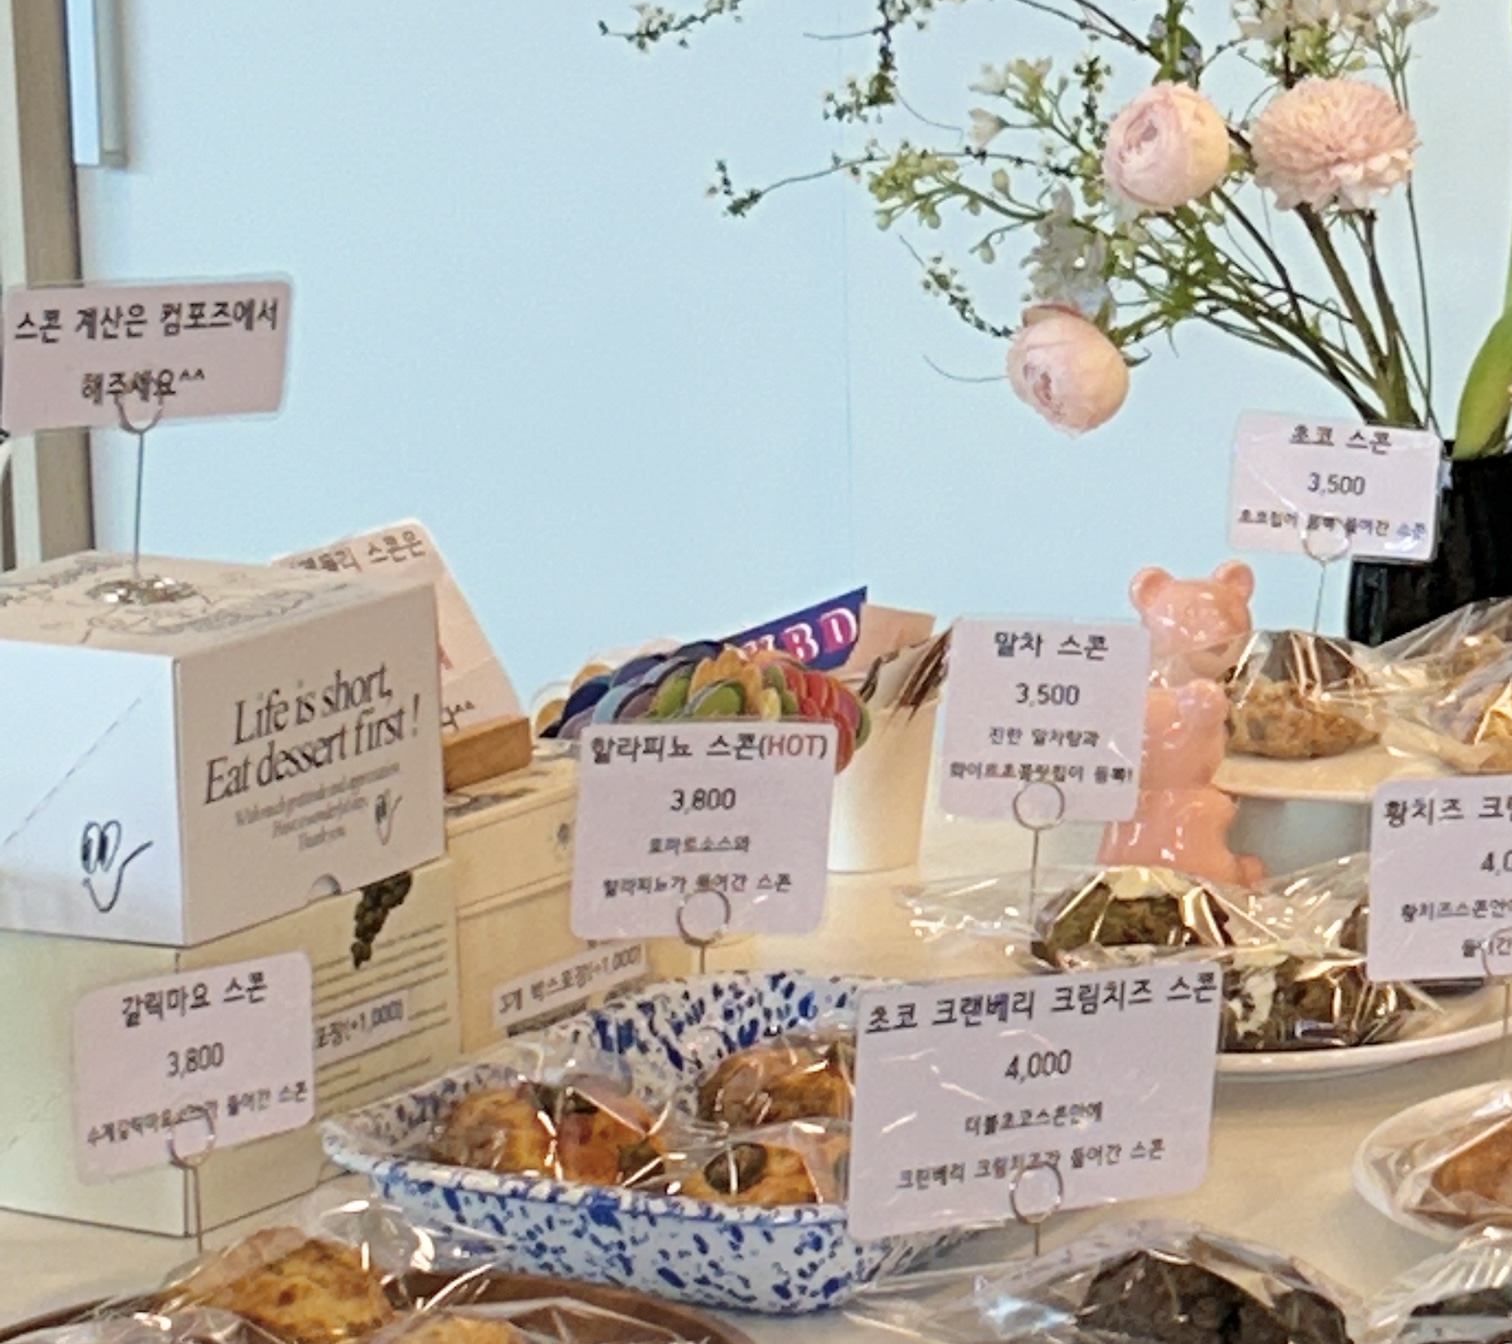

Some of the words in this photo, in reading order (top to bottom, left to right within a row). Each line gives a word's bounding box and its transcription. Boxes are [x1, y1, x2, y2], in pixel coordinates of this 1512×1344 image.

[14, 309, 62, 344] 스콘
[75, 303, 148, 340] 계산은
[159, 296, 279, 337] 컴포즈에서
[1289, 424, 1335, 446] 초코
[1345, 429, 1392, 455] 스콘
[1307, 471, 1367, 496] 3,500
[367, 529, 426, 564] 스콘은
[994, 631, 1043, 657] 말차
[1057, 634, 1109, 661] 스콘
[233, 687, 290, 745] Life
[295, 678, 317, 726] is
[321, 661, 393, 718] short,
[1015, 682, 1080, 707] 3,500
[204, 755, 252, 804] Eat
[256, 723, 347, 787] dessert
[591, 735, 693, 765] 할라피뇨
[706, 733, 828, 761] 스콘(HOT)
[670, 788, 736, 814] 3,800
[1384, 798, 1464, 828] 황치즈
[756, 872, 792, 893] 스콘
[121, 981, 211, 1029] 갈릭마요
[223, 971, 268, 1004] 스콘
[864, 1002, 918, 1035] 초코
[931, 991, 1036, 1028] 크랜베리
[1051, 978, 1153, 1015] 크림치즈
[1166, 971, 1218, 1004] 스콘
[166, 1041, 226, 1079] 3,800
[1004, 1049, 1073, 1086] 4,000
[278, 1080, 309, 1104] 스콘
[1130, 1137, 1165, 1161] 스콘
